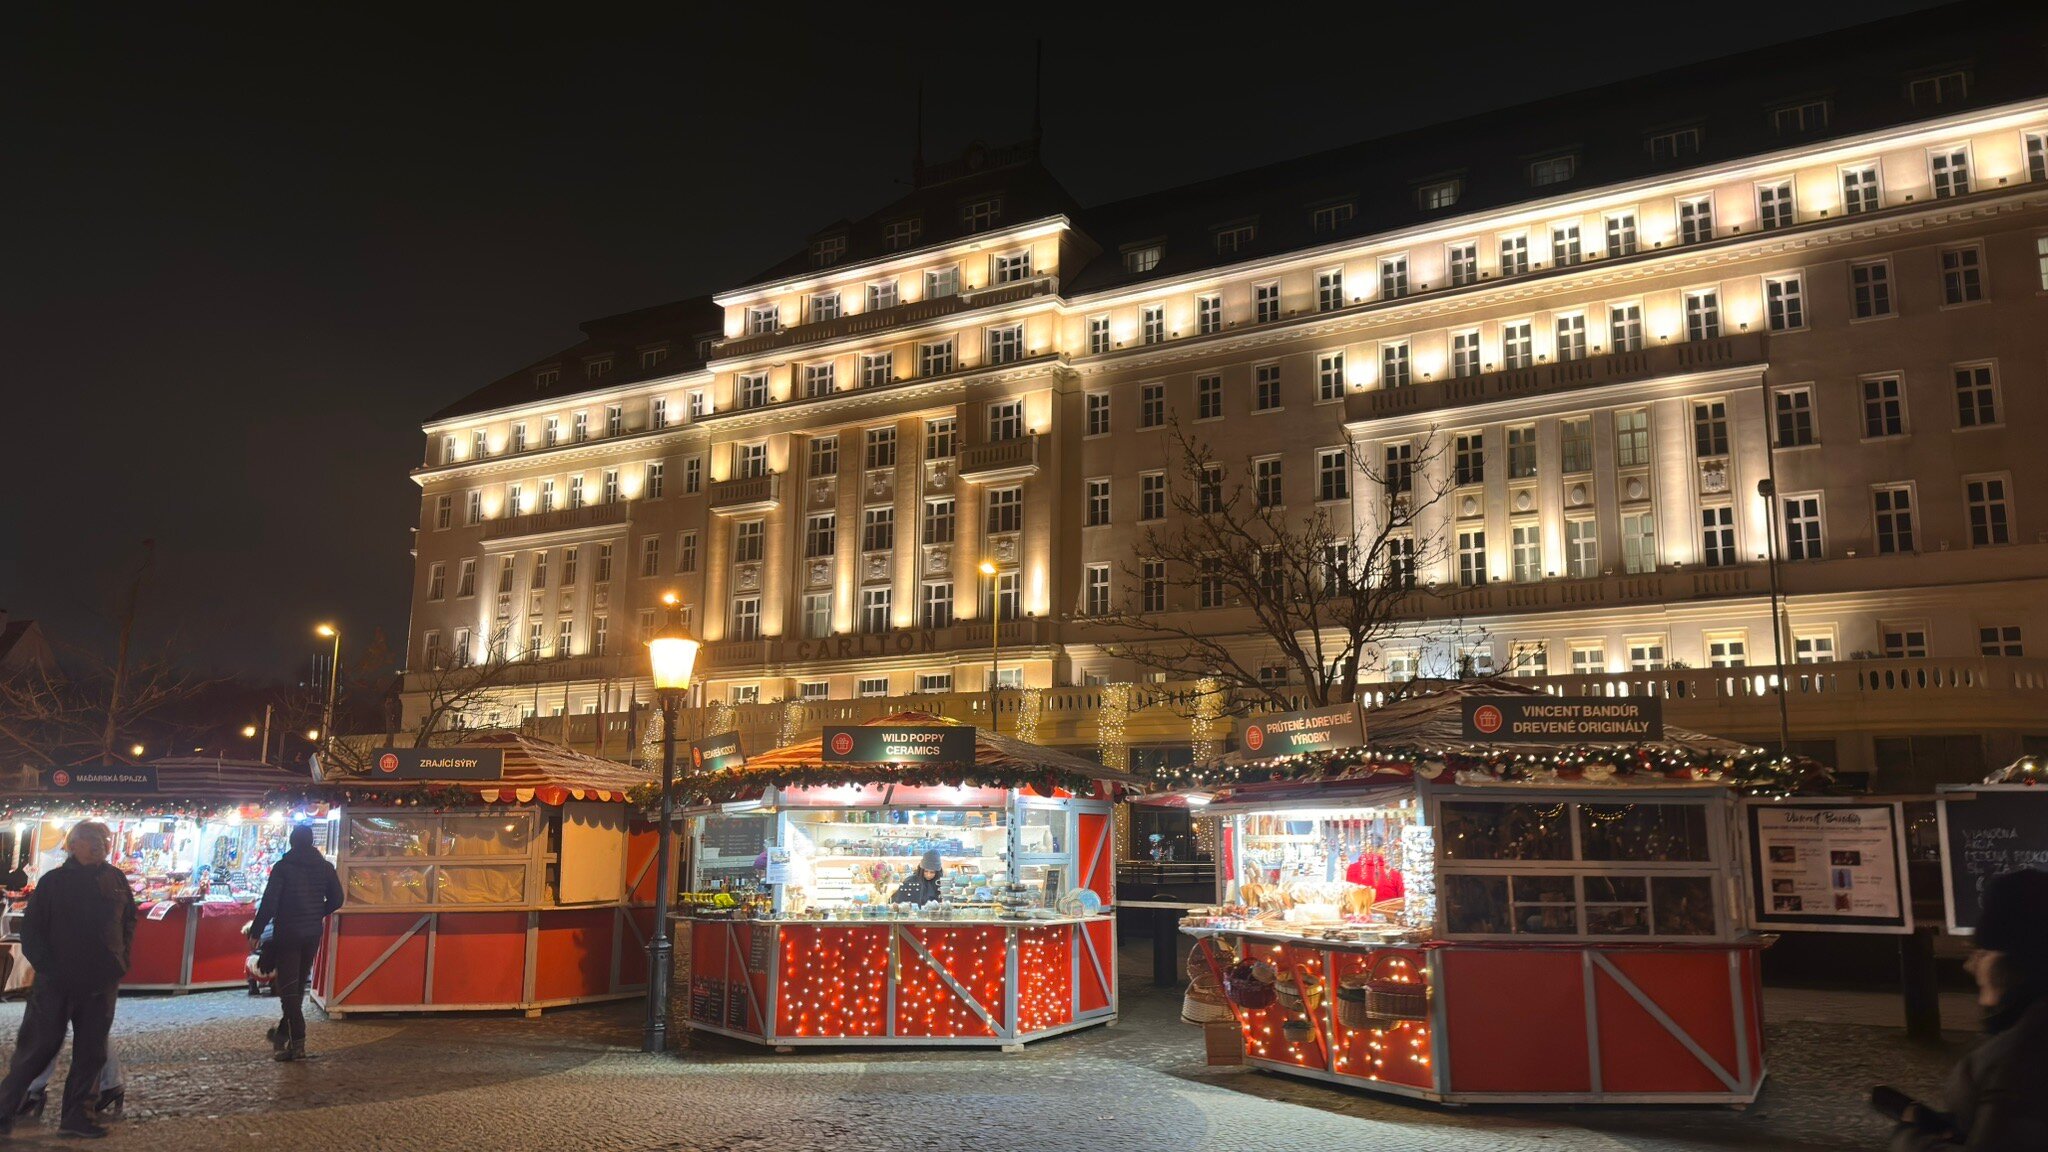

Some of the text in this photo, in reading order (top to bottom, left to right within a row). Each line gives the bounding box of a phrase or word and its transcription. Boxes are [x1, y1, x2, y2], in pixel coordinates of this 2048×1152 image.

[797, 631, 936, 659] CARLTON
[1522, 703, 1639, 717] VINCENT BANDÚR
[1266, 717, 1305, 734] PRÚTENÉ
[1312, 712, 1353, 728] DREVENÉ
[1513, 720, 1650, 733] DREVENÉ ORIGINÁLY
[882, 733, 945, 743] WILD POPPY
[1290, 731, 1331, 745] VÝROBKY
[885, 745, 940, 756] CERAMICS
[420, 758, 478, 768] ZRAJÍCÍ SÝRY
